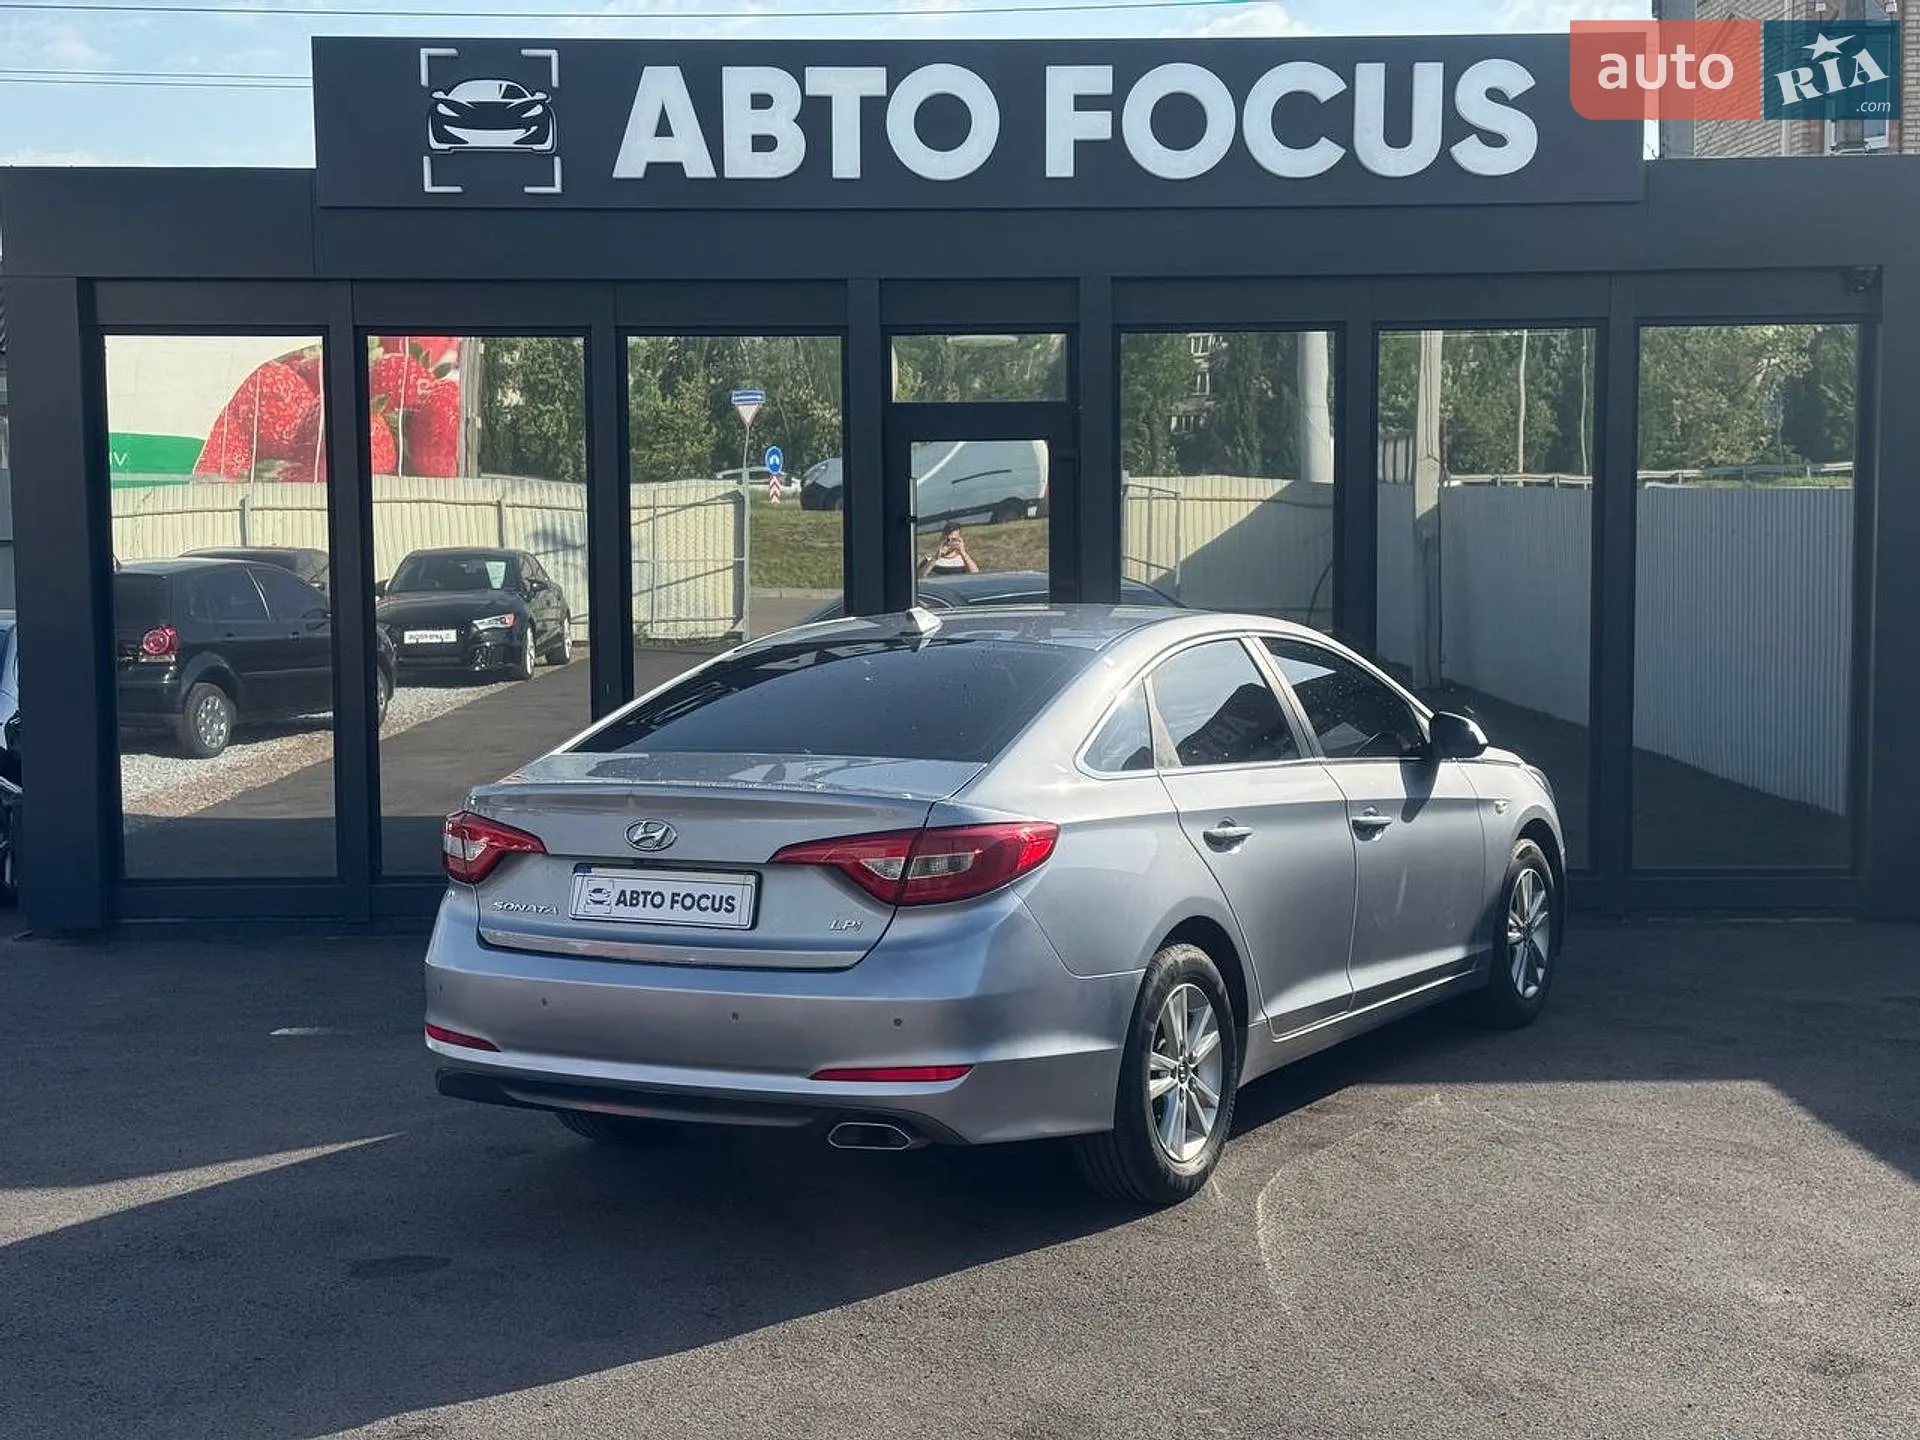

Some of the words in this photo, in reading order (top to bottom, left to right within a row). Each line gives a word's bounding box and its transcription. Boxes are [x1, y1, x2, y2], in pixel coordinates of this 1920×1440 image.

[613, 63, 1000, 180] АВТО
[1046, 59, 1538, 180] FOCUS
[492, 900, 560, 916] SONATA
[615, 889, 665, 909] АВТО
[670, 892, 736, 914] FOCUS
